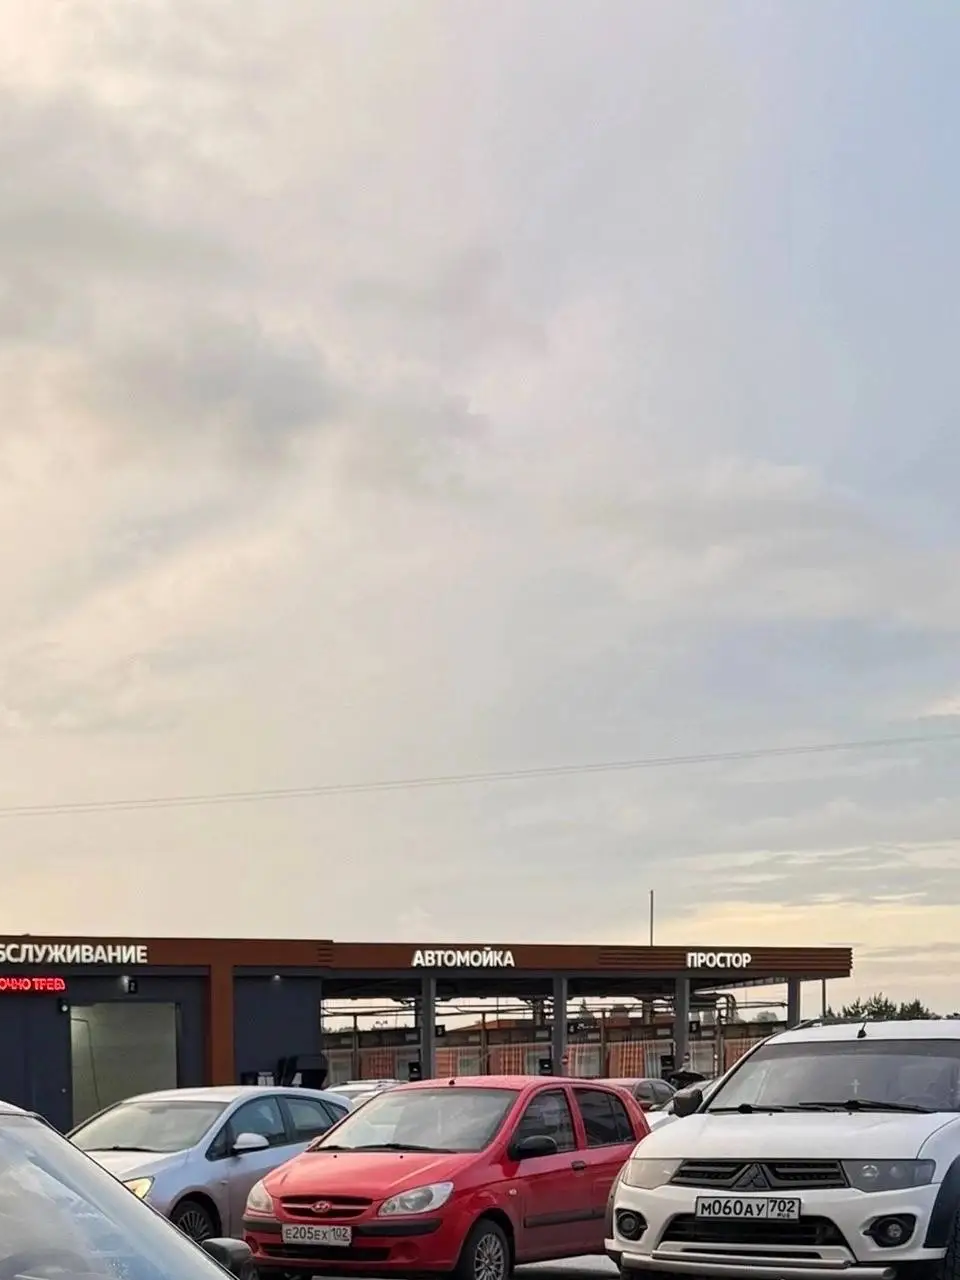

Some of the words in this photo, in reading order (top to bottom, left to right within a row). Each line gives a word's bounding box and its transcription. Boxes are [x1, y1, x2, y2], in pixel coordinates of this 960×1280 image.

[411, 946, 516, 968] АВТОМОЙКА
[686, 952, 752, 968] ПРОСТОР
[700, 1199, 765, 1216] М060АУ
[769, 1199, 796, 1213] 702
[285, 1226, 328, 1241] Е205ЕХ
